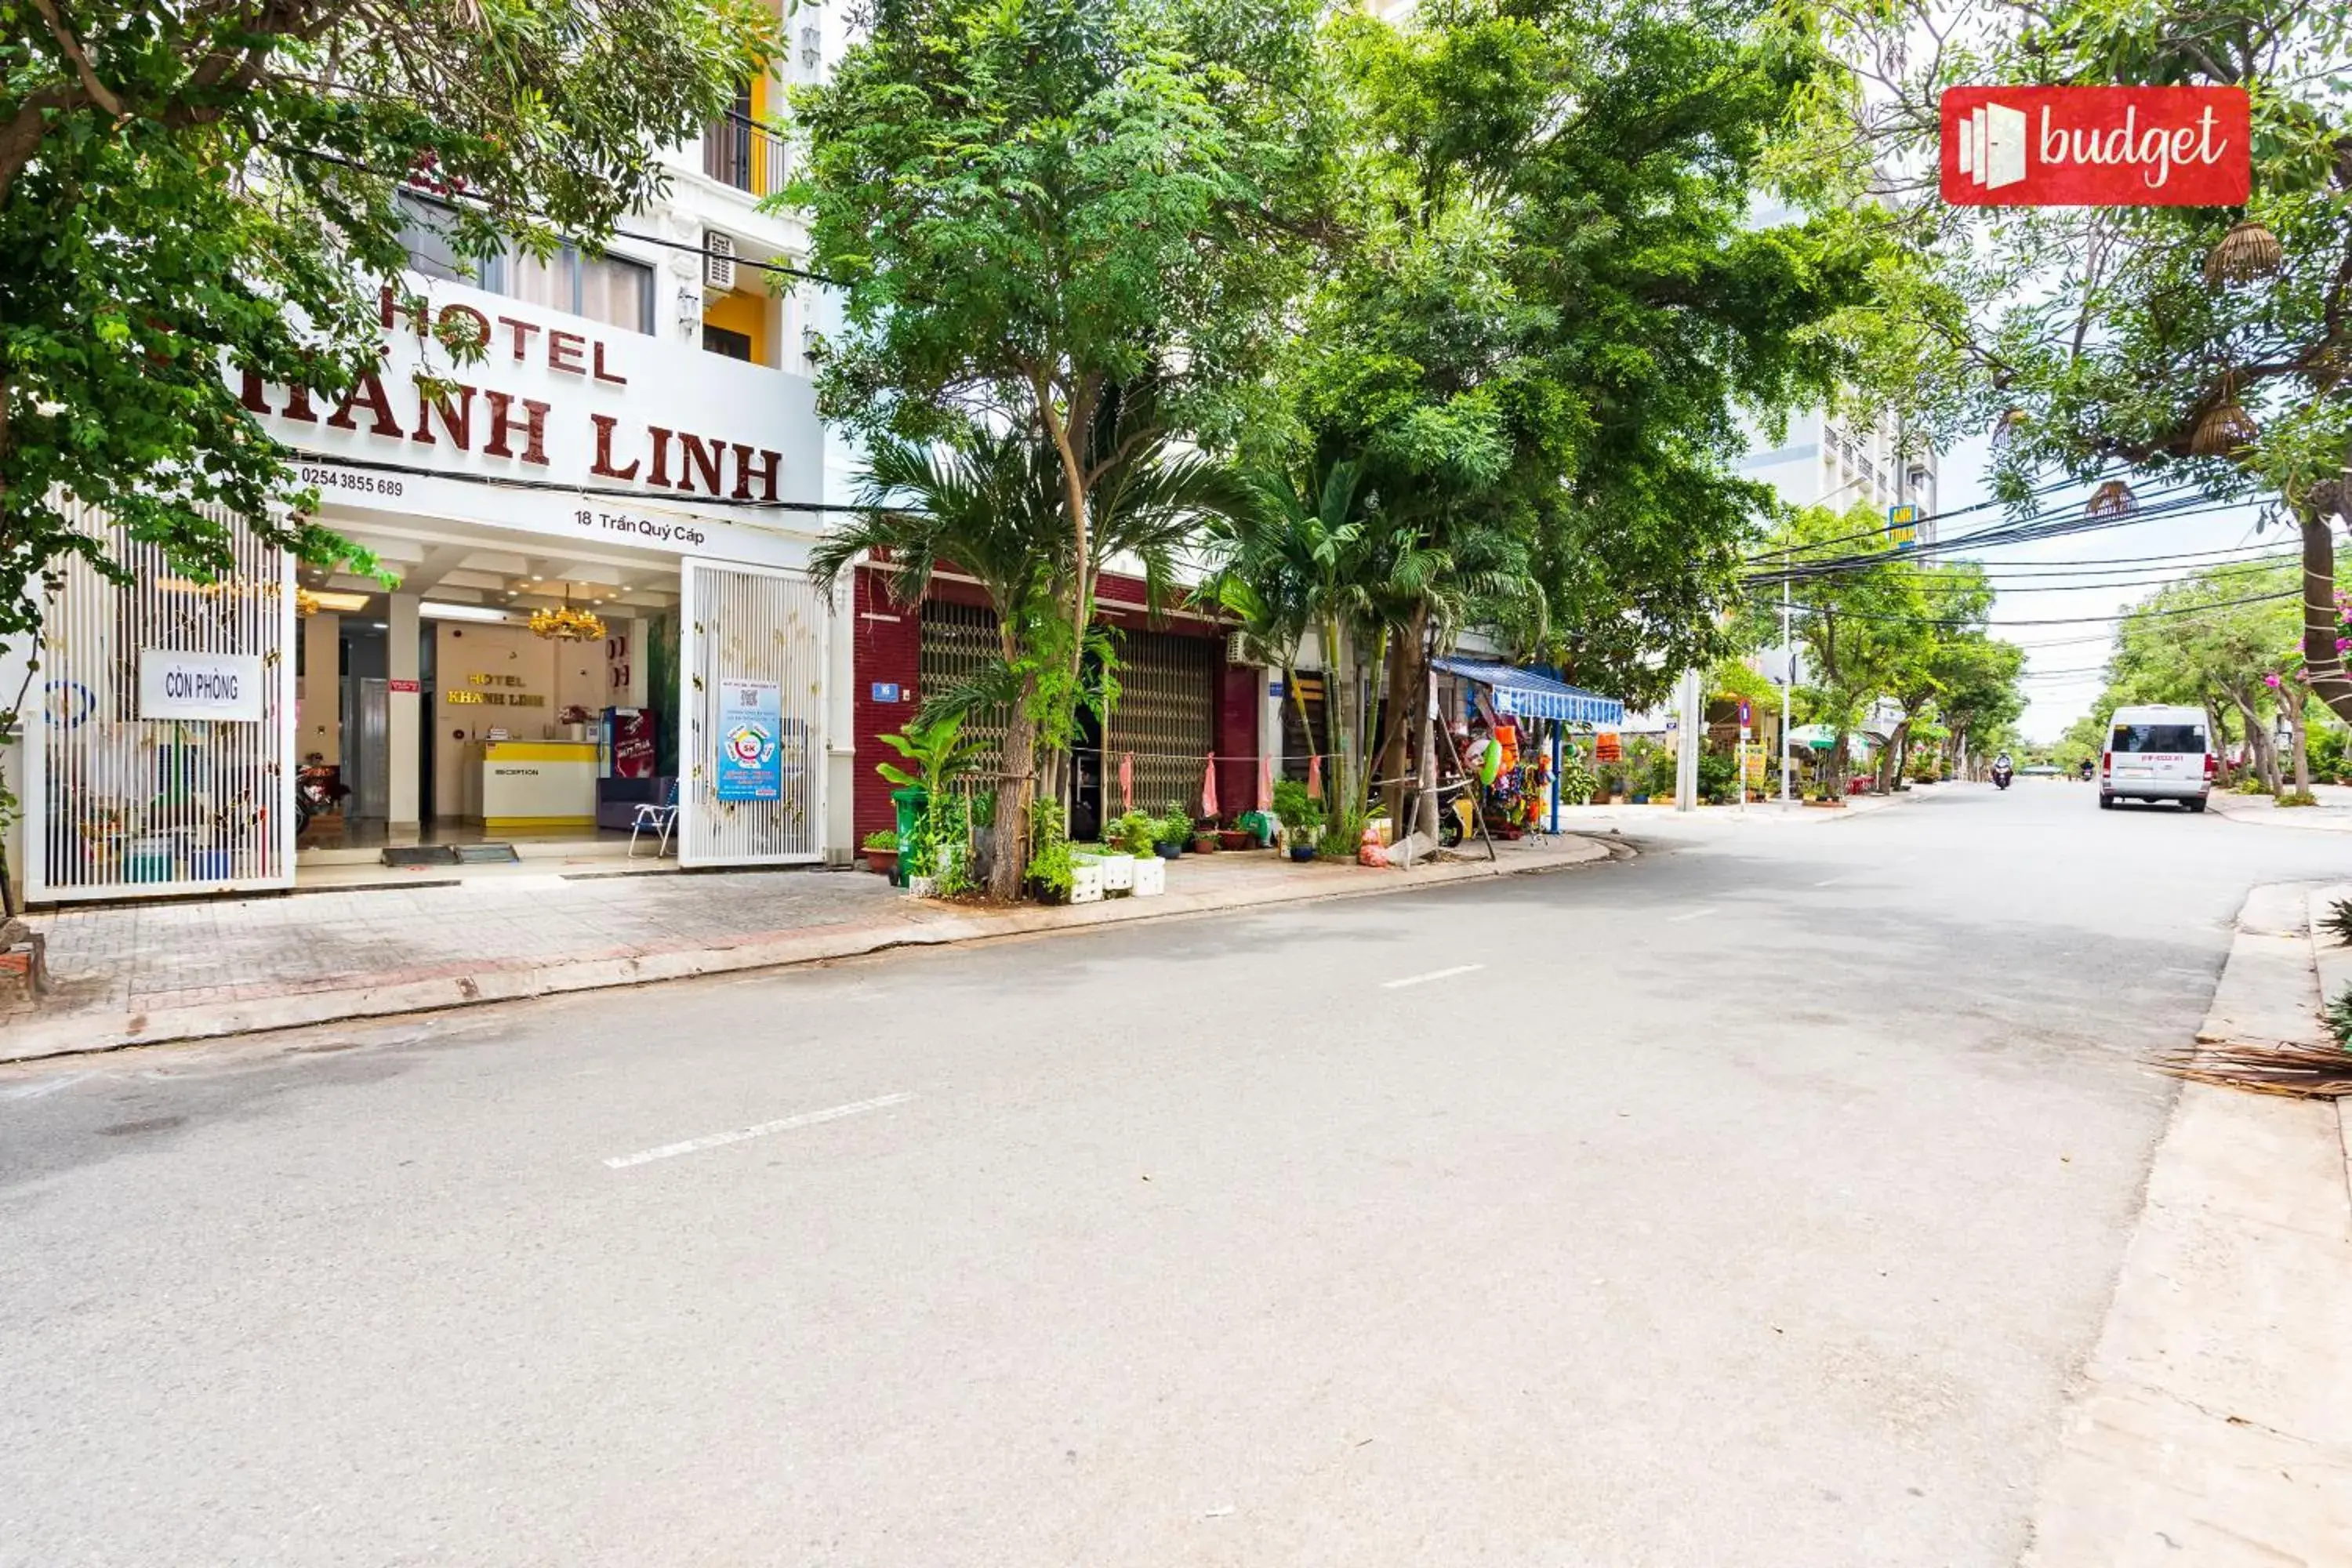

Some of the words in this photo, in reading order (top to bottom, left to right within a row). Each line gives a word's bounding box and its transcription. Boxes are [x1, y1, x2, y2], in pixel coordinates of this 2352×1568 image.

[381, 286, 627, 384] HOTEL
[590, 413, 782, 501] LINH
[302, 467, 337, 487] 0254
[341, 474, 374, 492] 3855
[377, 479, 402, 496] 689
[575, 510, 592, 526] 18
[165, 664, 192, 699] CÒN
[196, 666, 238, 700] PHÒNG
[467, 673, 527, 688] HOTEL
